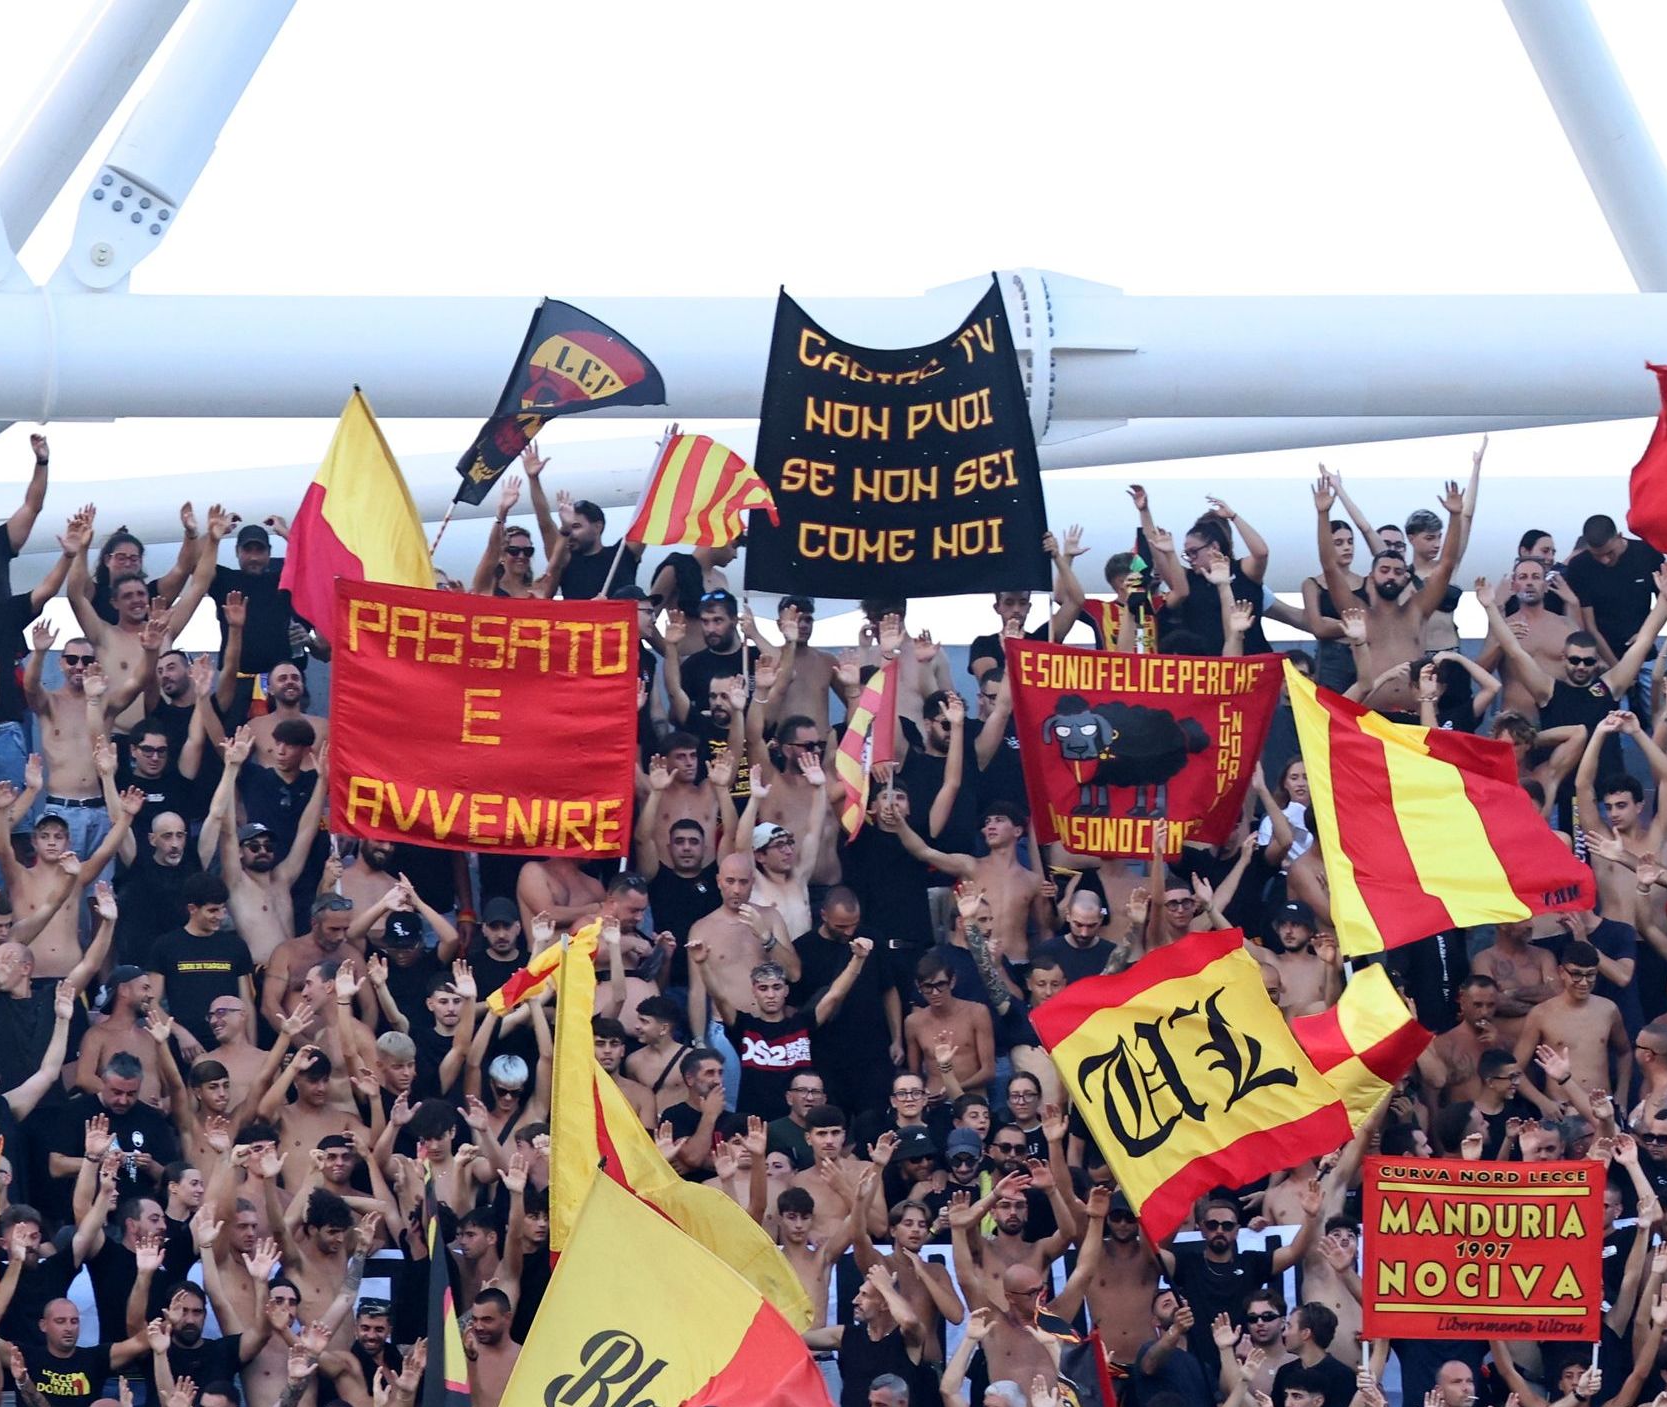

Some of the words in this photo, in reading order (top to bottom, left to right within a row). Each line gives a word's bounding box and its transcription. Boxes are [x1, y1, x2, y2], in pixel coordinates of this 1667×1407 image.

[805, 396, 890, 441] NON
[780, 457, 836, 497] SE
[852, 466, 938, 503] NON
[954, 448, 1019, 496] SEI
[798, 521, 916, 563] COME
[932, 518, 1004, 560] NOI
[349, 600, 630, 676] PASSATO
[461, 689, 503, 746] E
[347, 777, 625, 852] AVVENIRE
[1379, 1167, 1451, 1182] CURVA
[1460, 1170, 1520, 1183] NORD
[1529, 1170, 1587, 1184] LECCE
[1379, 1197, 1587, 1239] MANDURIA
[1455, 1241, 1513, 1259] 1997
[1378, 1260, 1584, 1300] NOCIVA
